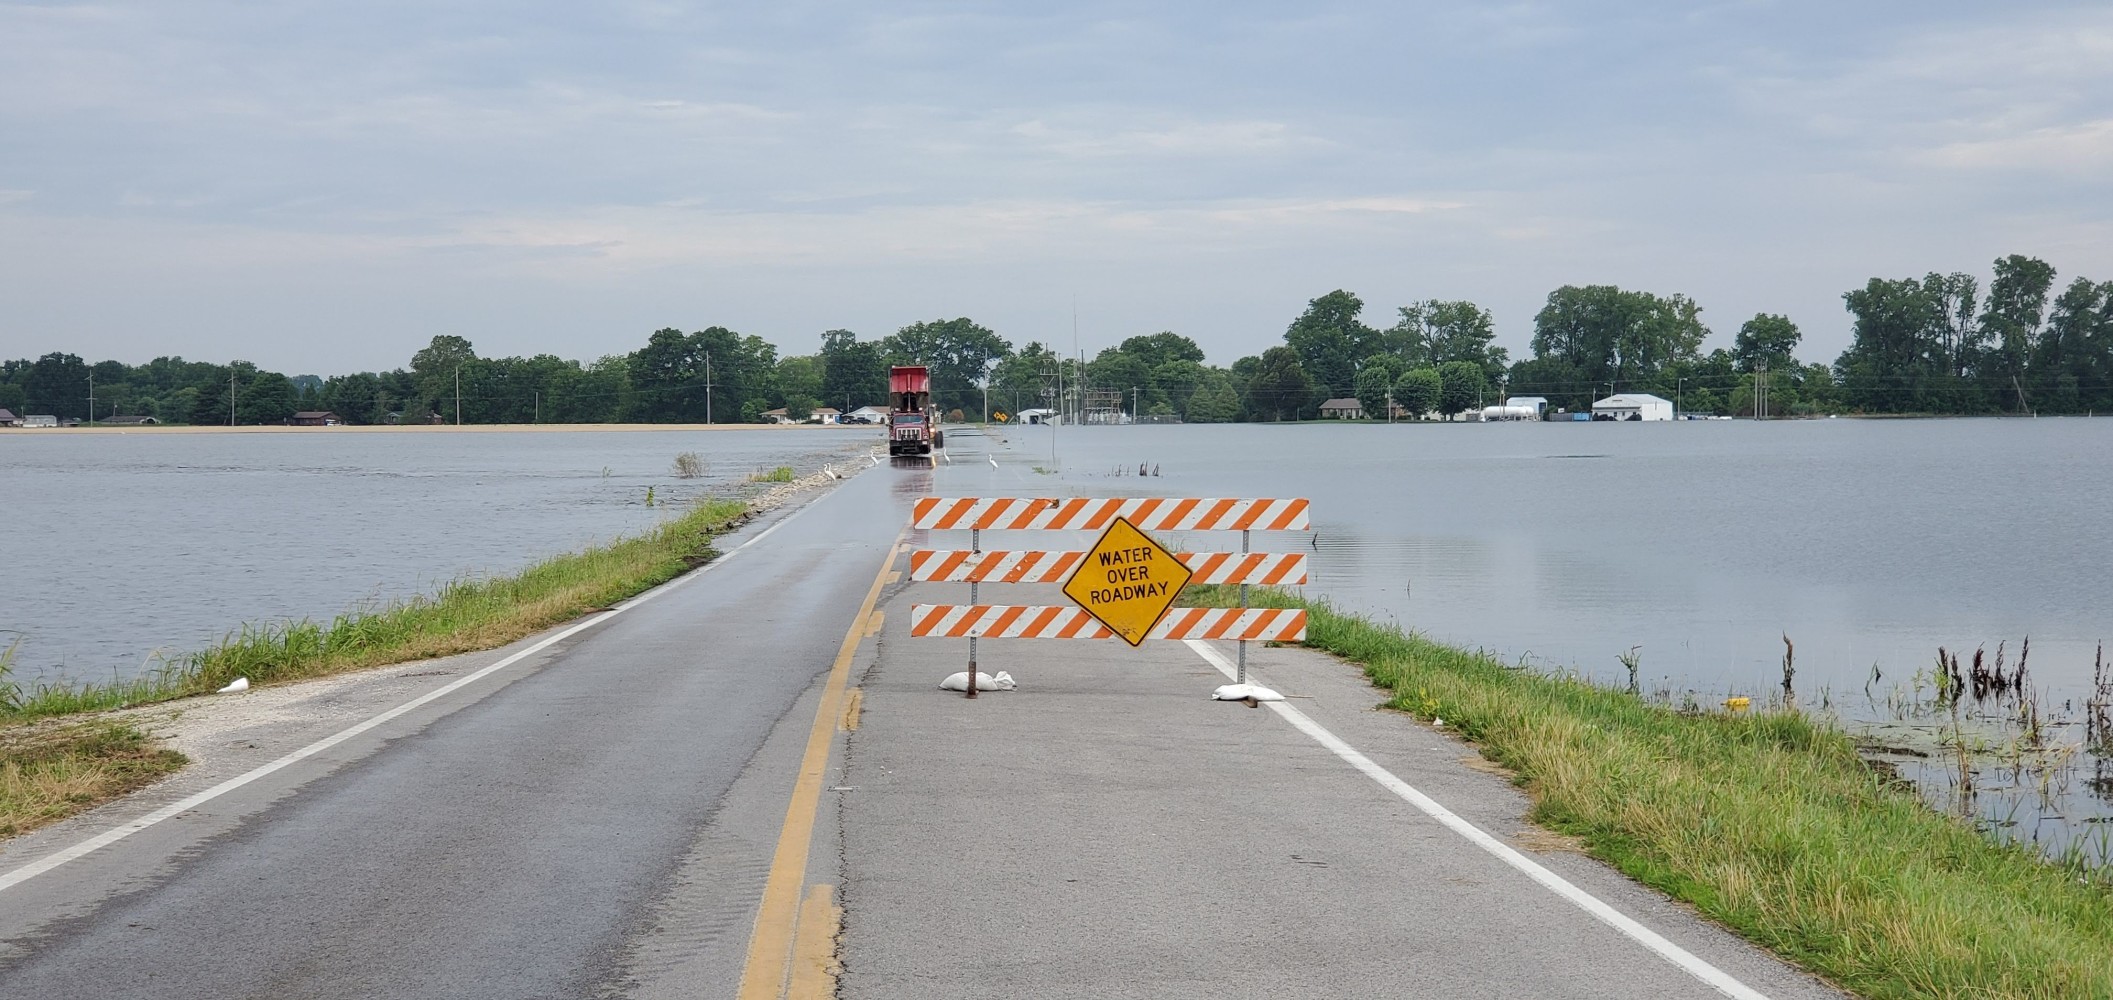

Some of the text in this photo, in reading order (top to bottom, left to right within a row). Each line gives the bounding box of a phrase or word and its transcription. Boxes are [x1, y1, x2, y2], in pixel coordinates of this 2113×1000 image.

[1099, 547, 1153, 566] WATER
[1107, 566, 1149, 584] OVER
[1090, 581, 1169, 605] ROADWAY
